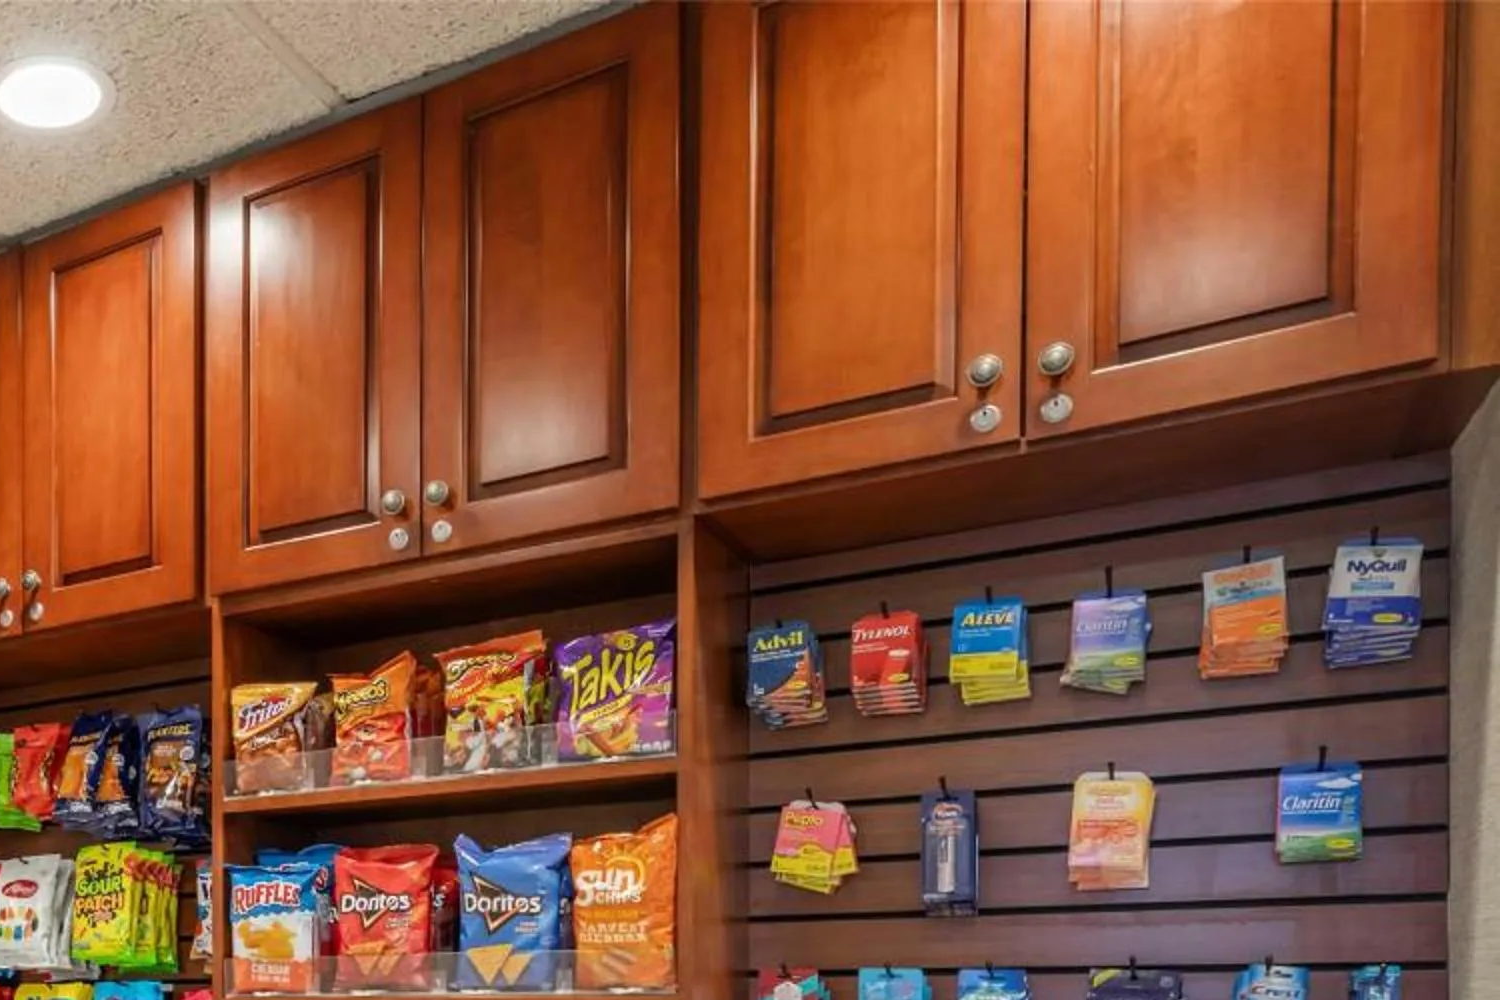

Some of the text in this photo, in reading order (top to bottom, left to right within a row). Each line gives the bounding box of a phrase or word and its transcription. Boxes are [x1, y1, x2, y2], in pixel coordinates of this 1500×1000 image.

[1347, 559, 1407, 575] NyQuil
[963, 611, 1014, 626] ALEVE
[754, 631, 804, 651] Advil
[852, 626, 910, 643] TYLENOL
[562, 641, 656, 721] Takis
[1281, 794, 1341, 810] Claritin
[76, 875, 124, 894] SOUR
[232, 881, 301, 915] RUFFLES
[341, 892, 412, 914] Doritos
[464, 892, 543, 914] Doritos
